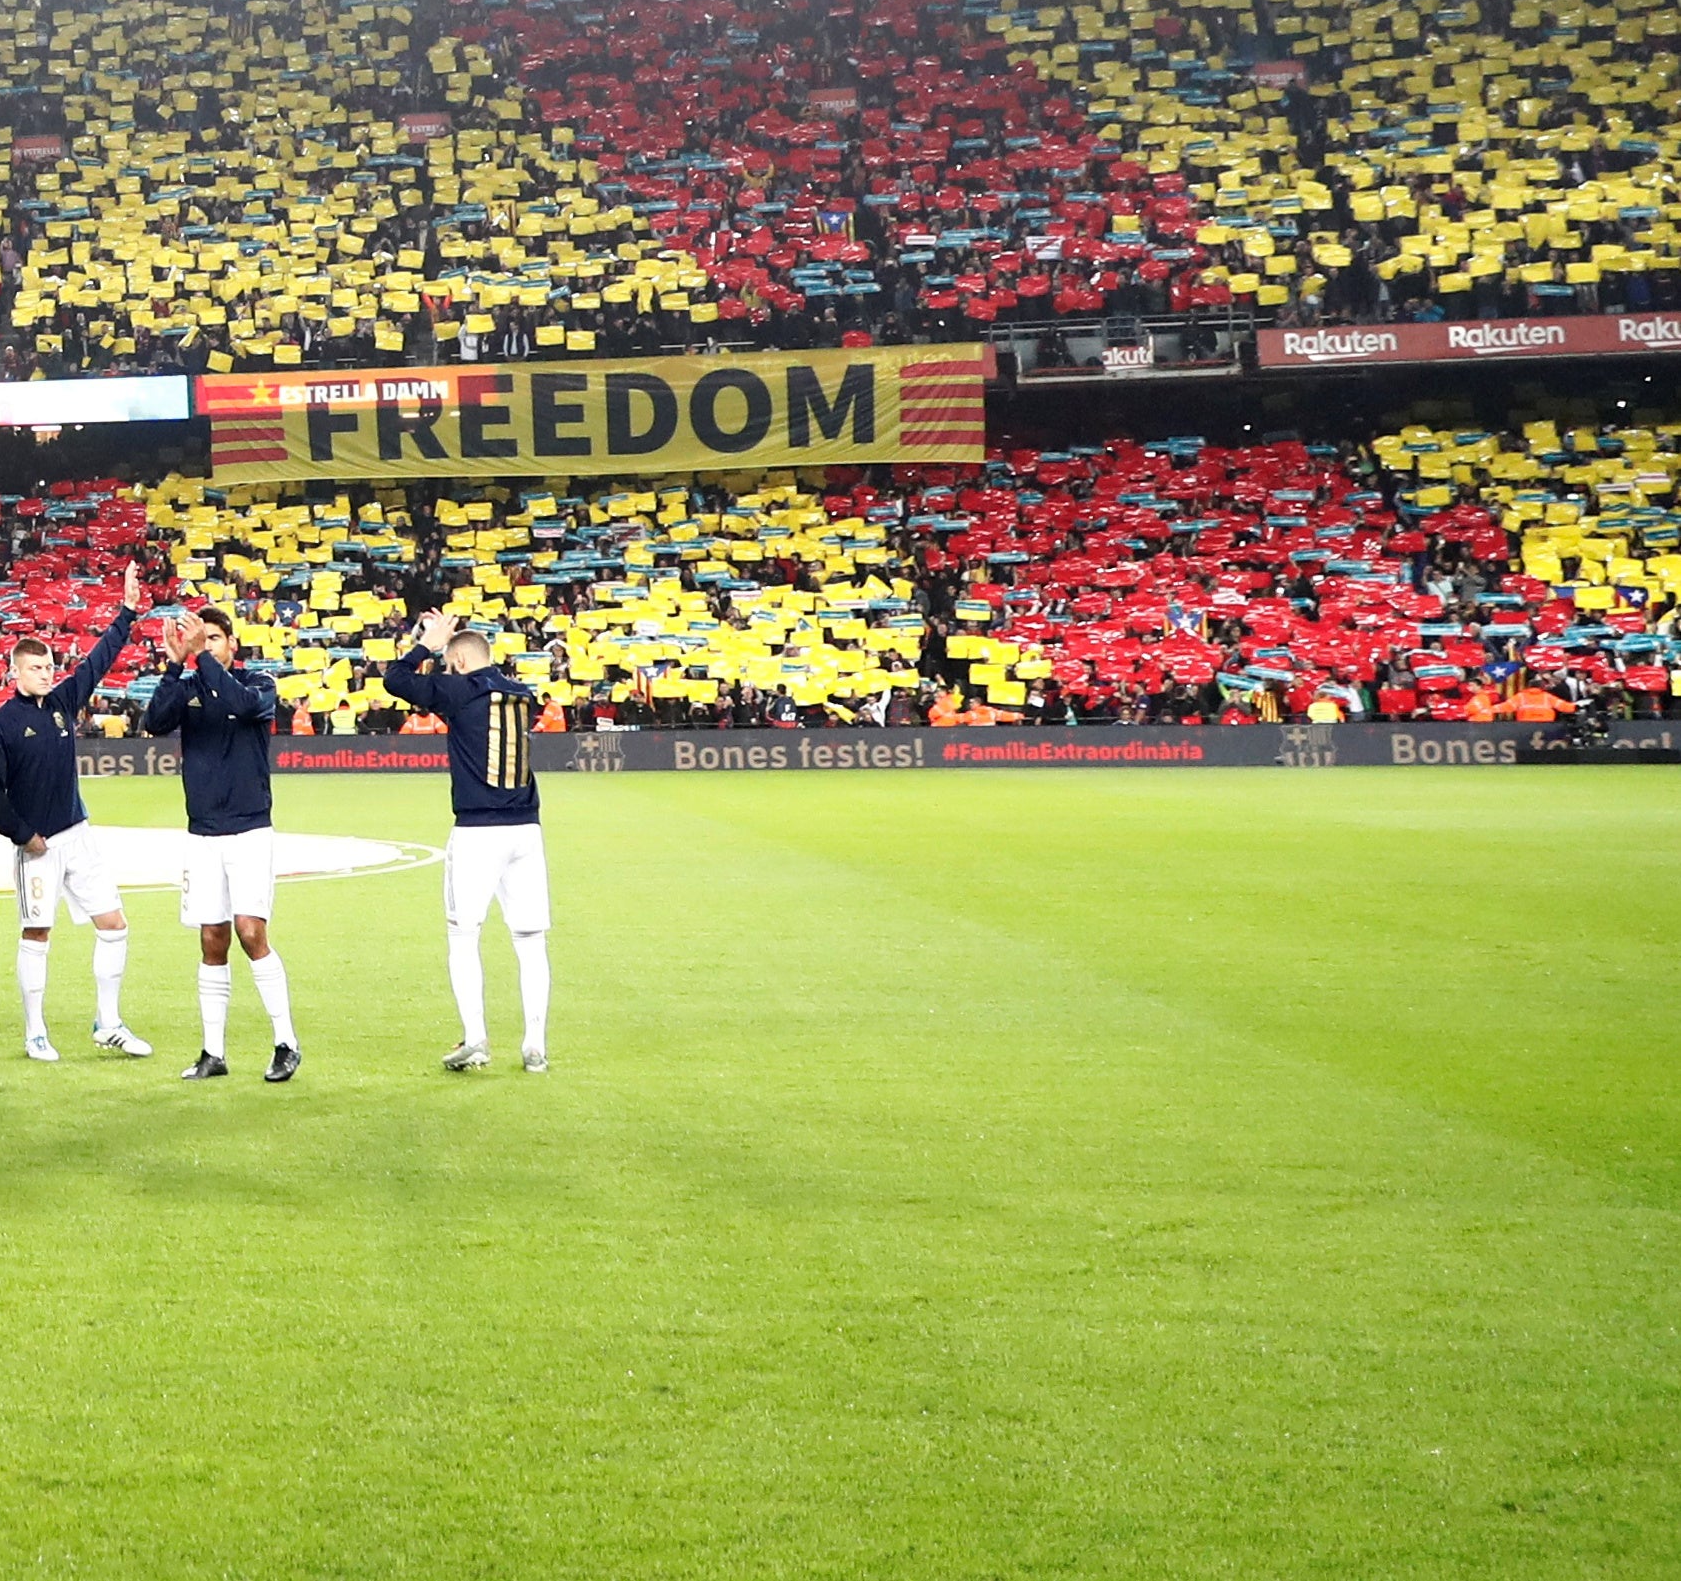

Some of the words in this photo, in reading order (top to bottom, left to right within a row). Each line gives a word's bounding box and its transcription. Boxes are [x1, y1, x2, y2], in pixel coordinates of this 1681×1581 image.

[1449, 323, 1565, 348] Rakuten
[1619, 318, 1681, 342] Raku
[1284, 331, 1397, 355] Rakuten
[279, 383, 377, 405] ESTRELLA
[383, 381, 448, 401] DAMM
[307, 364, 874, 461] FREEDOM
[675, 741, 788, 768] Bones
[799, 738, 925, 767] festes!
[943, 741, 1204, 762] #FamíliaExtraordinària
[1392, 733, 1516, 765] Bones
[31, 877, 43, 899] 8
[183, 870, 190, 893] 5
